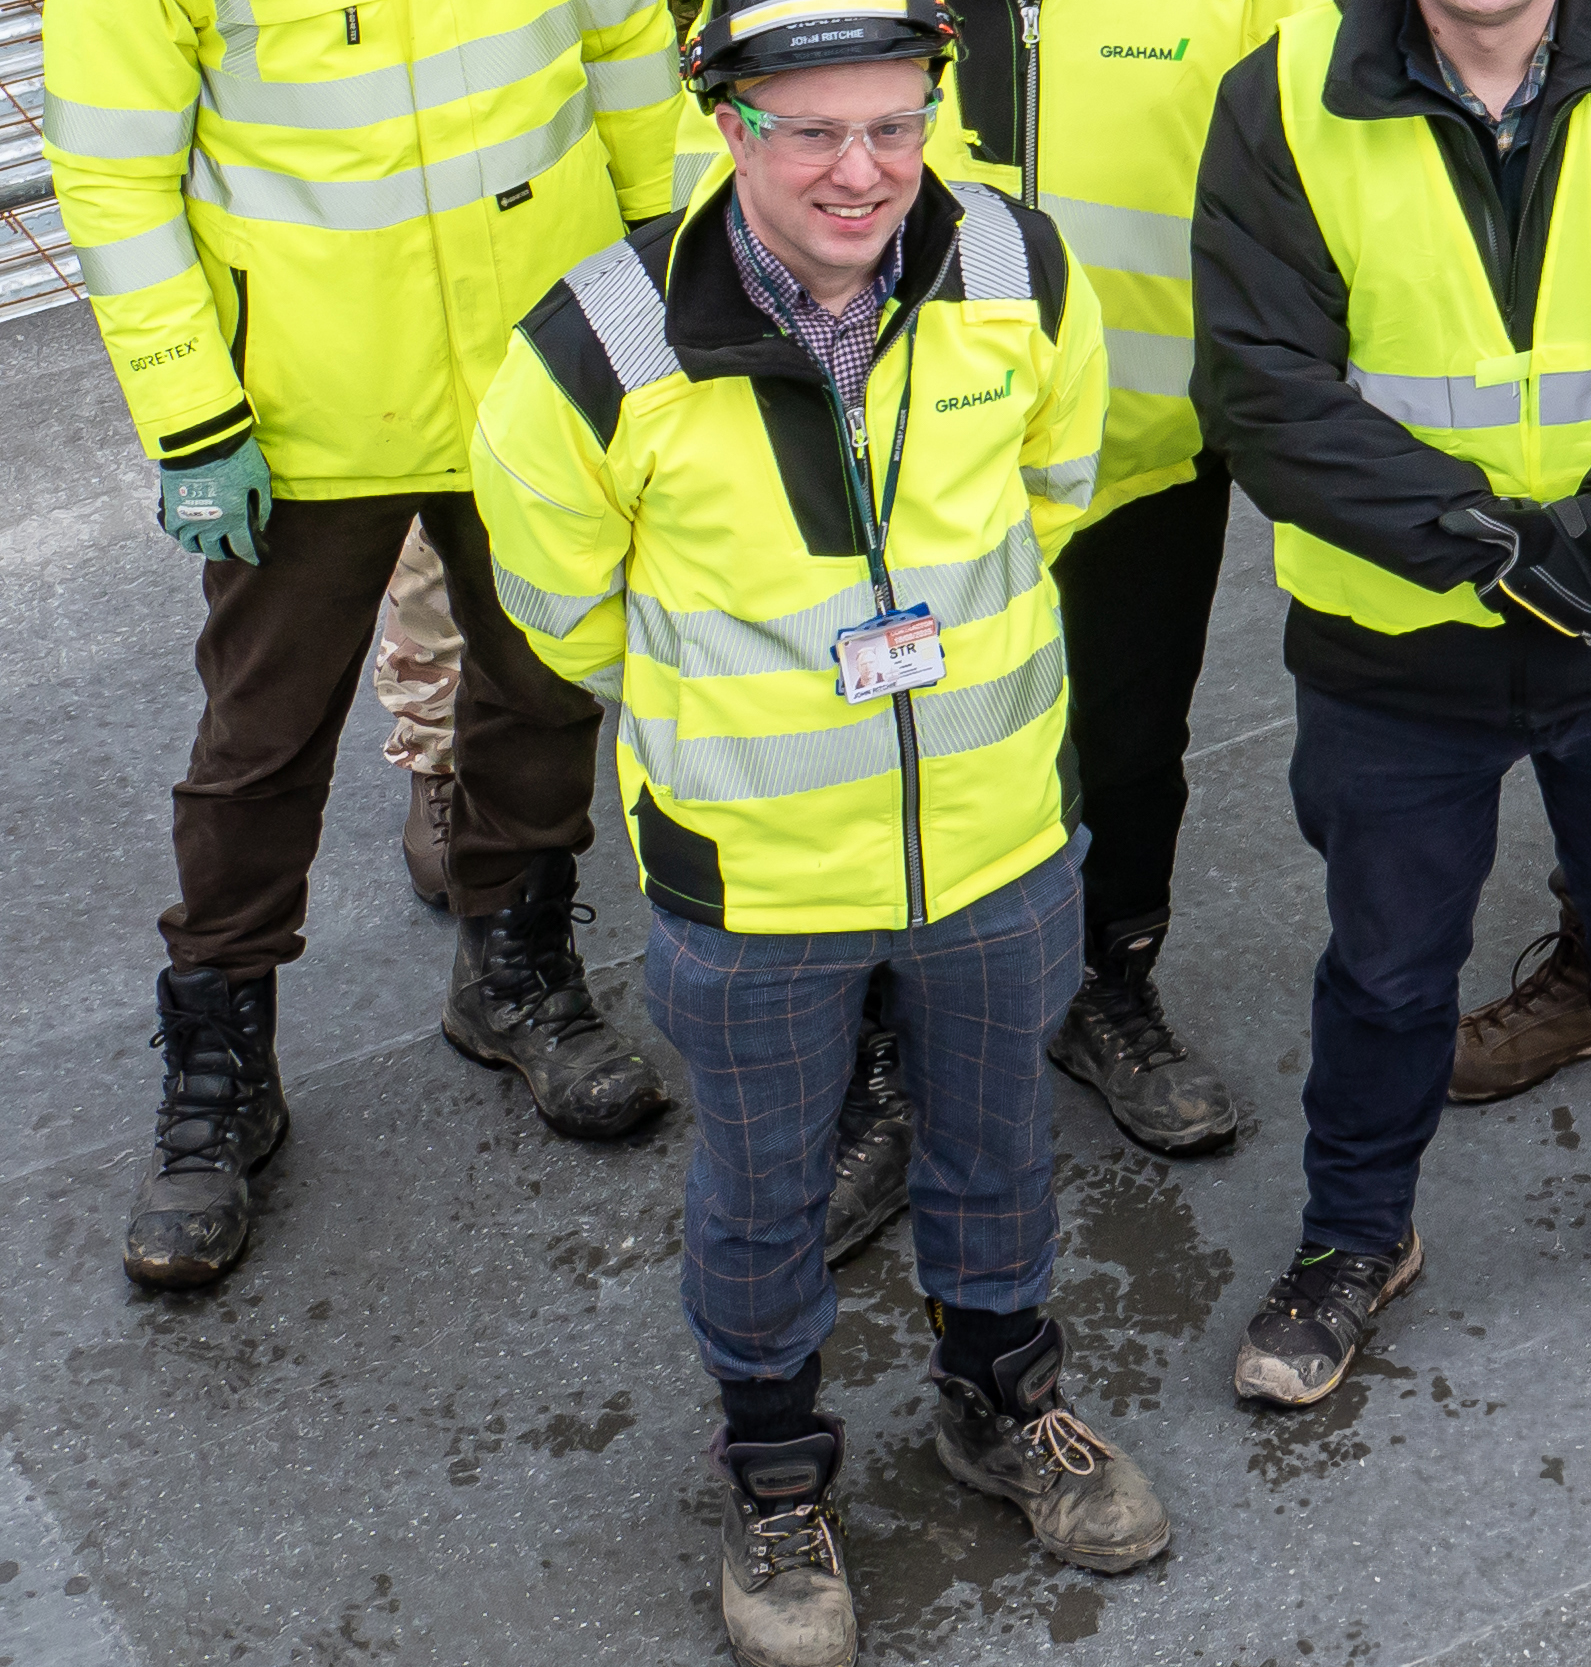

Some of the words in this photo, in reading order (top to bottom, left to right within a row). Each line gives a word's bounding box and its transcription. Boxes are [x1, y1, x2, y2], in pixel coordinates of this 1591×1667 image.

[820, 28, 864, 42] RITCHIE
[1100, 45, 1172, 60] GRAHAM
[935, 385, 1005, 413] GRAHAM
[888, 643, 917, 659] STR
